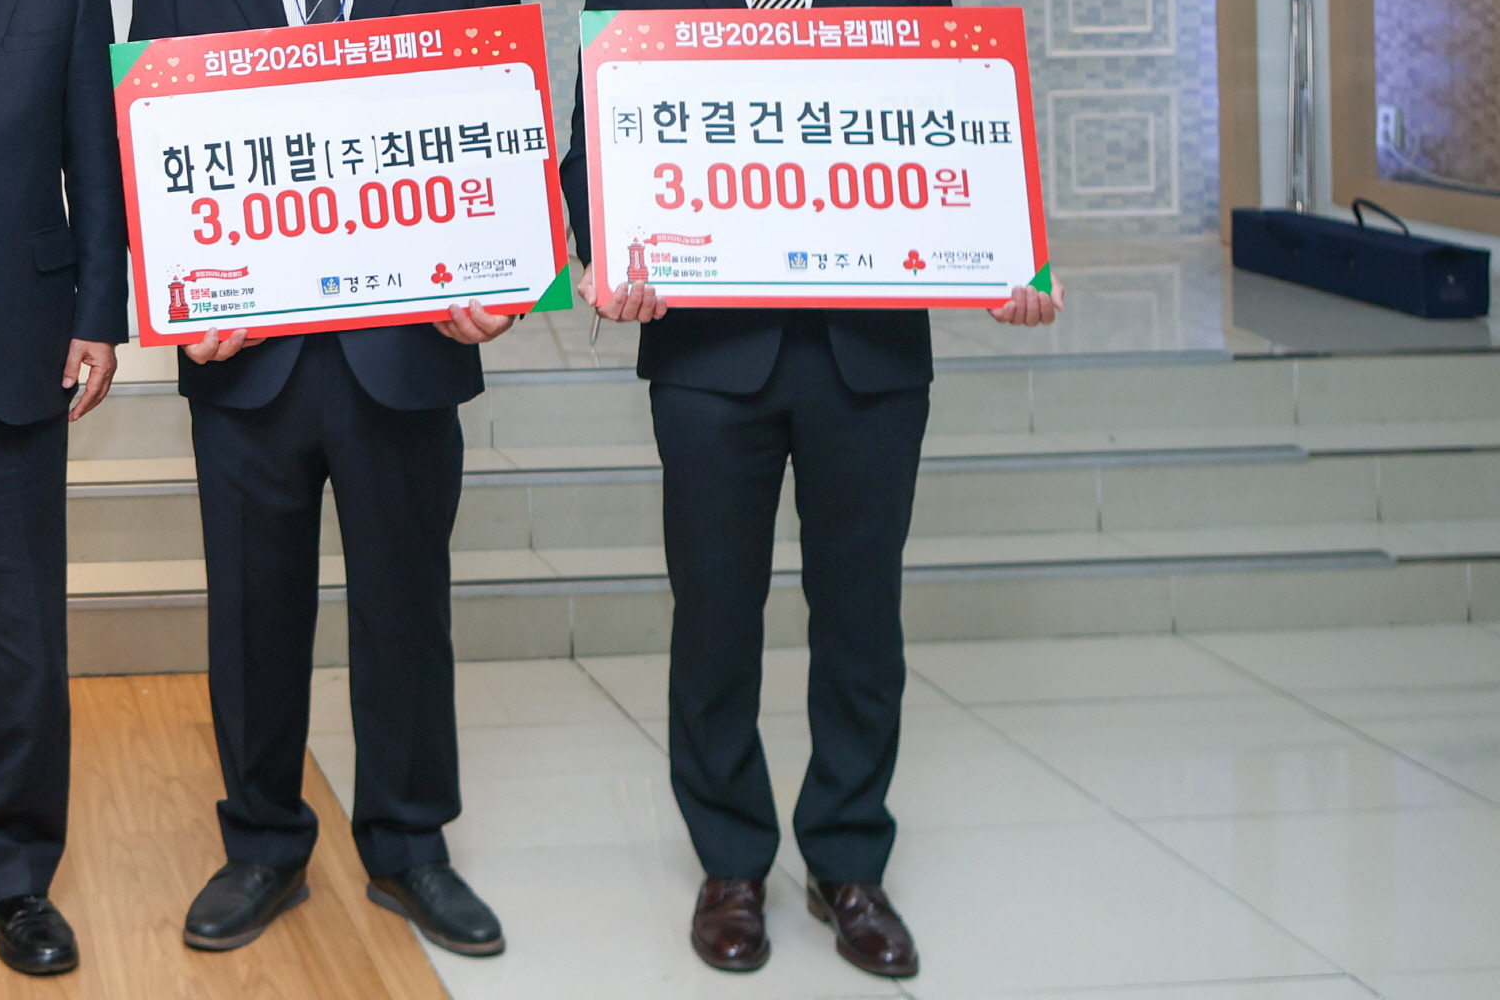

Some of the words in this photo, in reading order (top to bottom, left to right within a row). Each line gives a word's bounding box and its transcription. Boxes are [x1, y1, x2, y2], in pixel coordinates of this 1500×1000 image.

[675, 20, 920, 48] 희망2026나눔캠페인
[203, 30, 442, 77] 희망2026나눔캠페인
[654, 162, 971, 212] 3,000,000원
[192, 176, 495, 246] 3,000,000원
[457, 258, 517, 274] 사랑의열매
[811, 253, 873, 270] 경주시
[343, 272, 402, 293] 경주시
